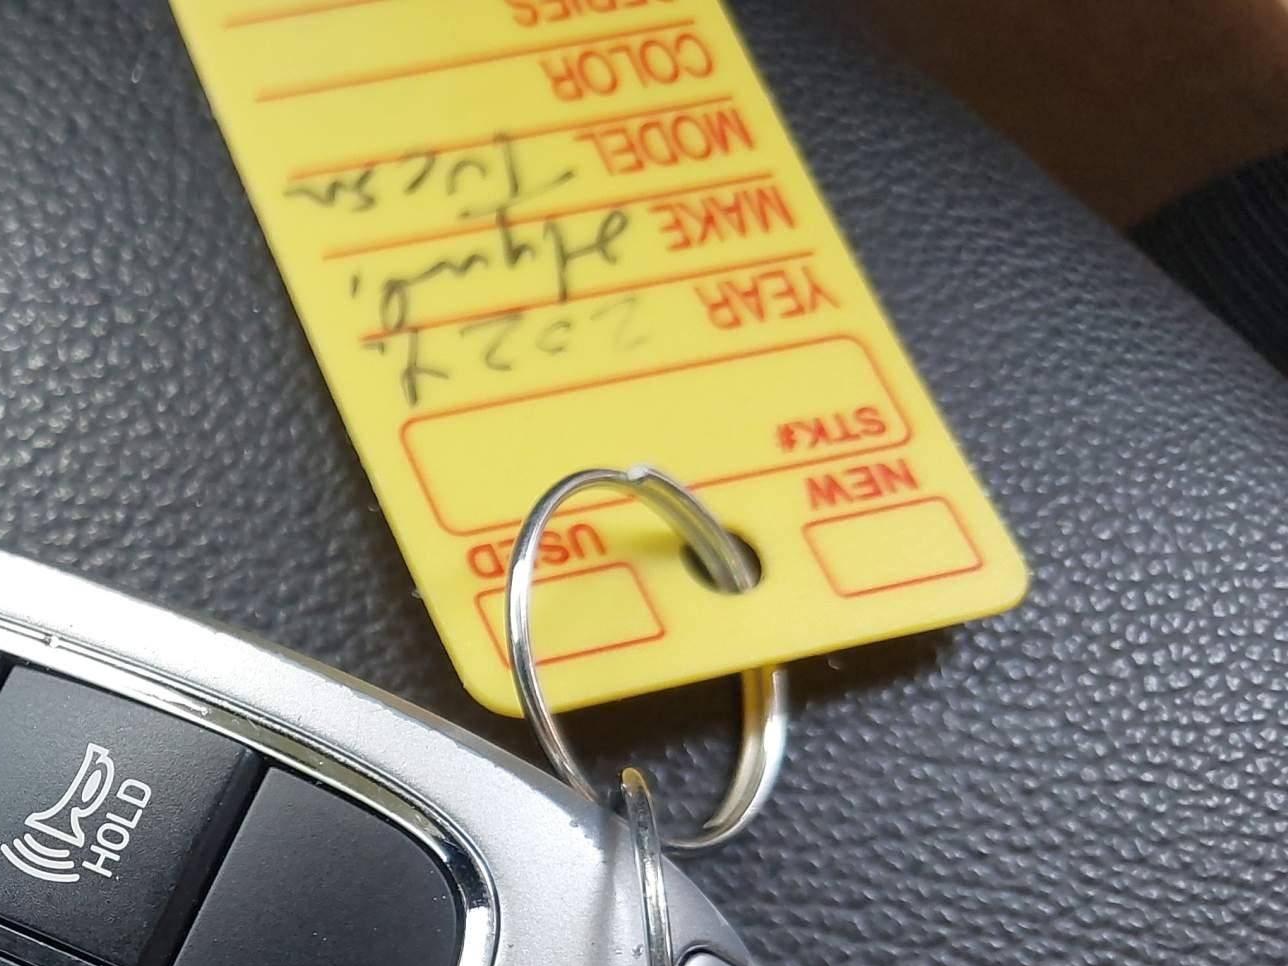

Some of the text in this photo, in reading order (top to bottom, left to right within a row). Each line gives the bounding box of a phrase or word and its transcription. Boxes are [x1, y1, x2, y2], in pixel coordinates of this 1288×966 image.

[539, 33, 713, 102] COLOR
[574, 108, 755, 175] MODEL
[648, 185, 796, 252] MAKE
[694, 266, 841, 331] YEAR
[775, 407, 888, 452] STK#
[805, 458, 919, 511] NEW
[82, 779, 152, 878] HOLD
